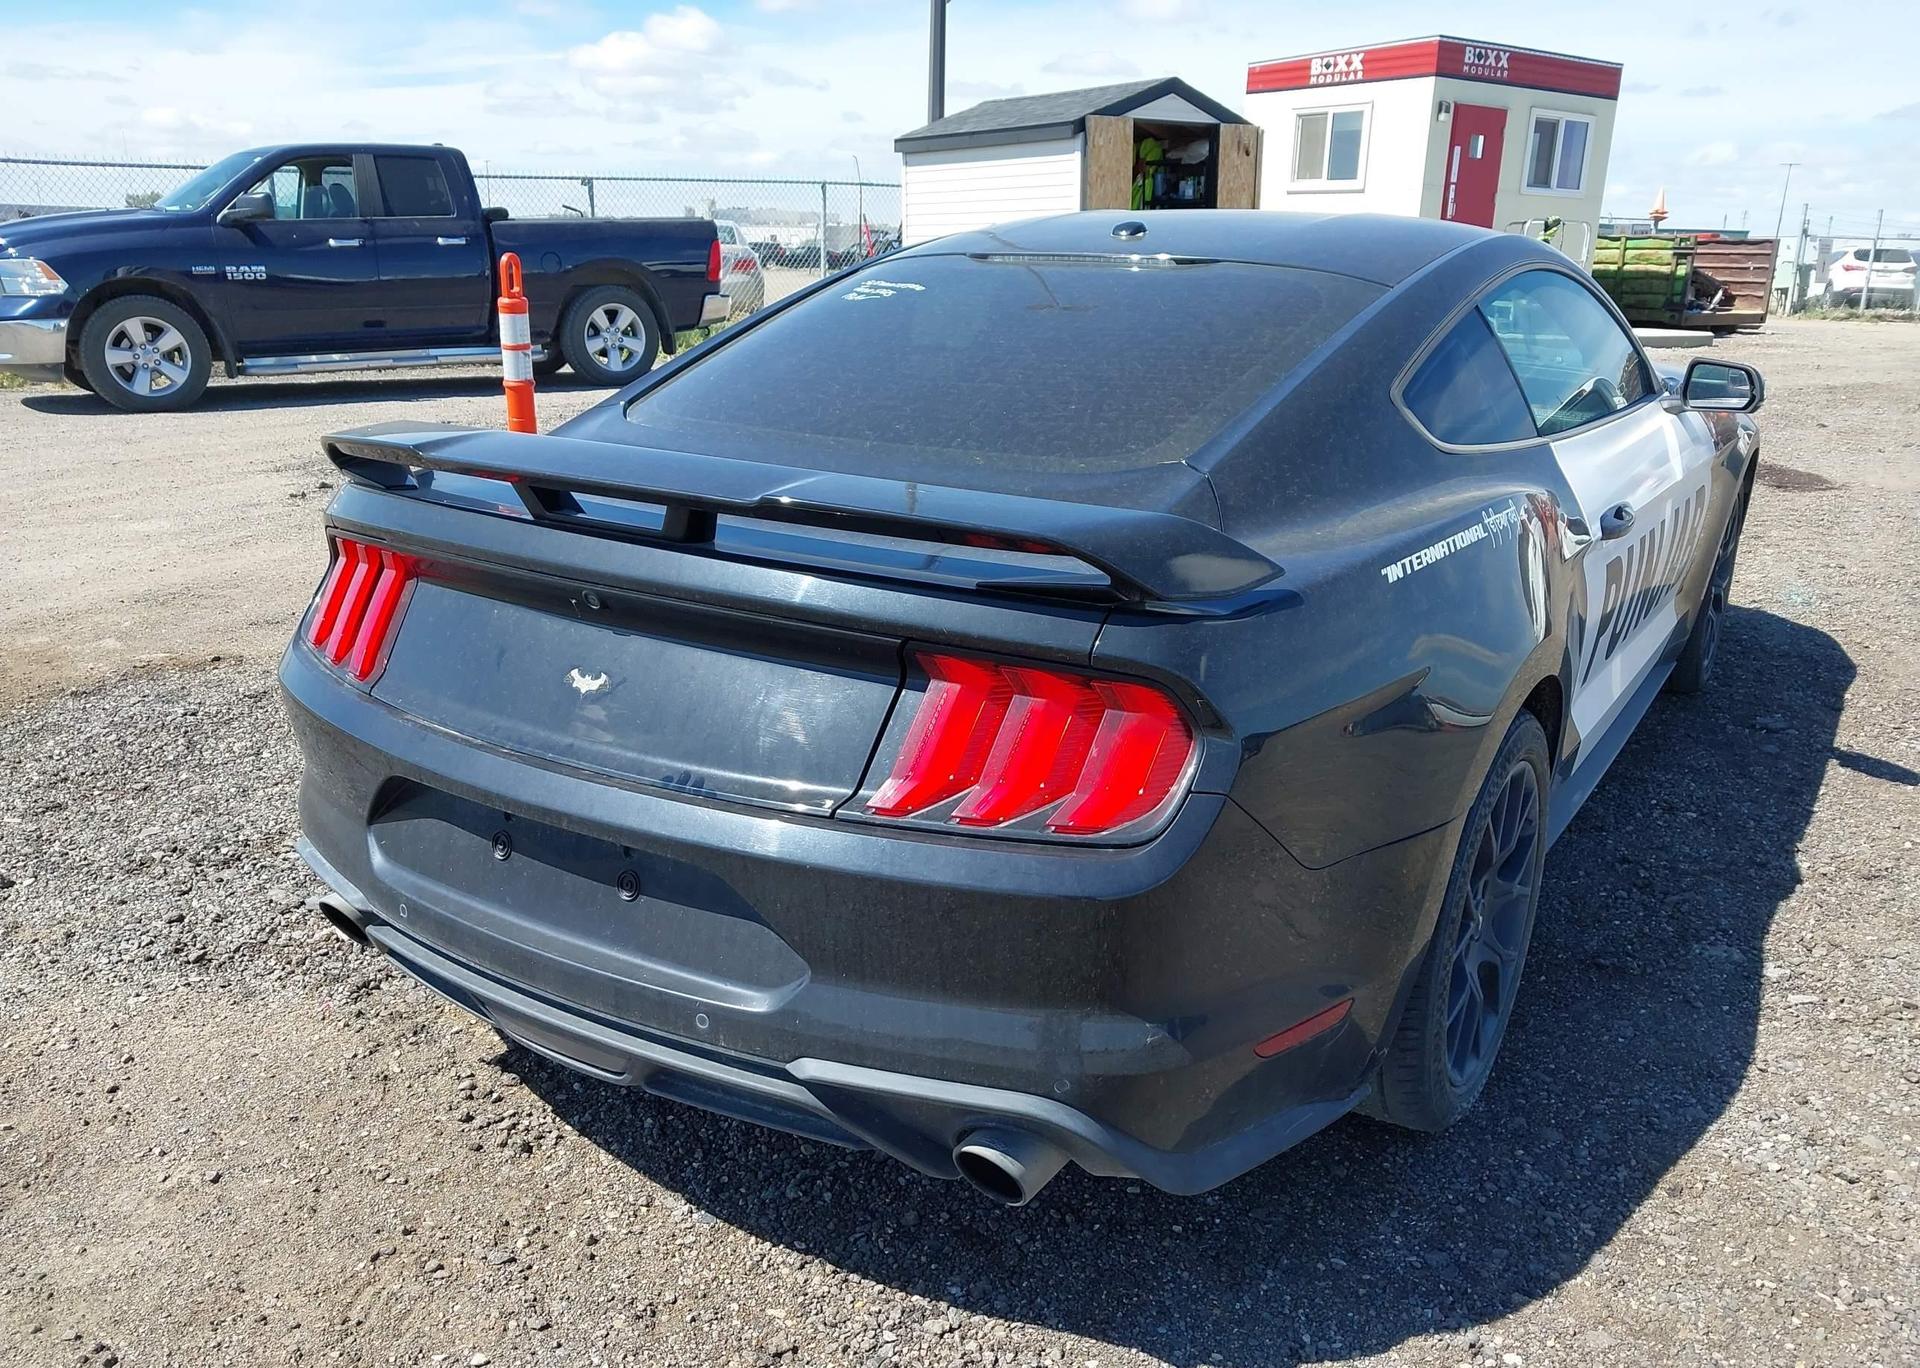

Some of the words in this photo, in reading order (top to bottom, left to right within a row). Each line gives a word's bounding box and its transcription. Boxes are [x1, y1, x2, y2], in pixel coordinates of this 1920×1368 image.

[1310, 52, 1365, 76] BOXX
[1464, 46, 1511, 69] BOXX
[1309, 70, 1364, 85] MODULAR
[1463, 64, 1509, 78] MODULAR
[225, 265, 266, 273] RAM
[226, 272, 267, 280] 1500
[1580, 484, 1706, 688] PUNJAB
